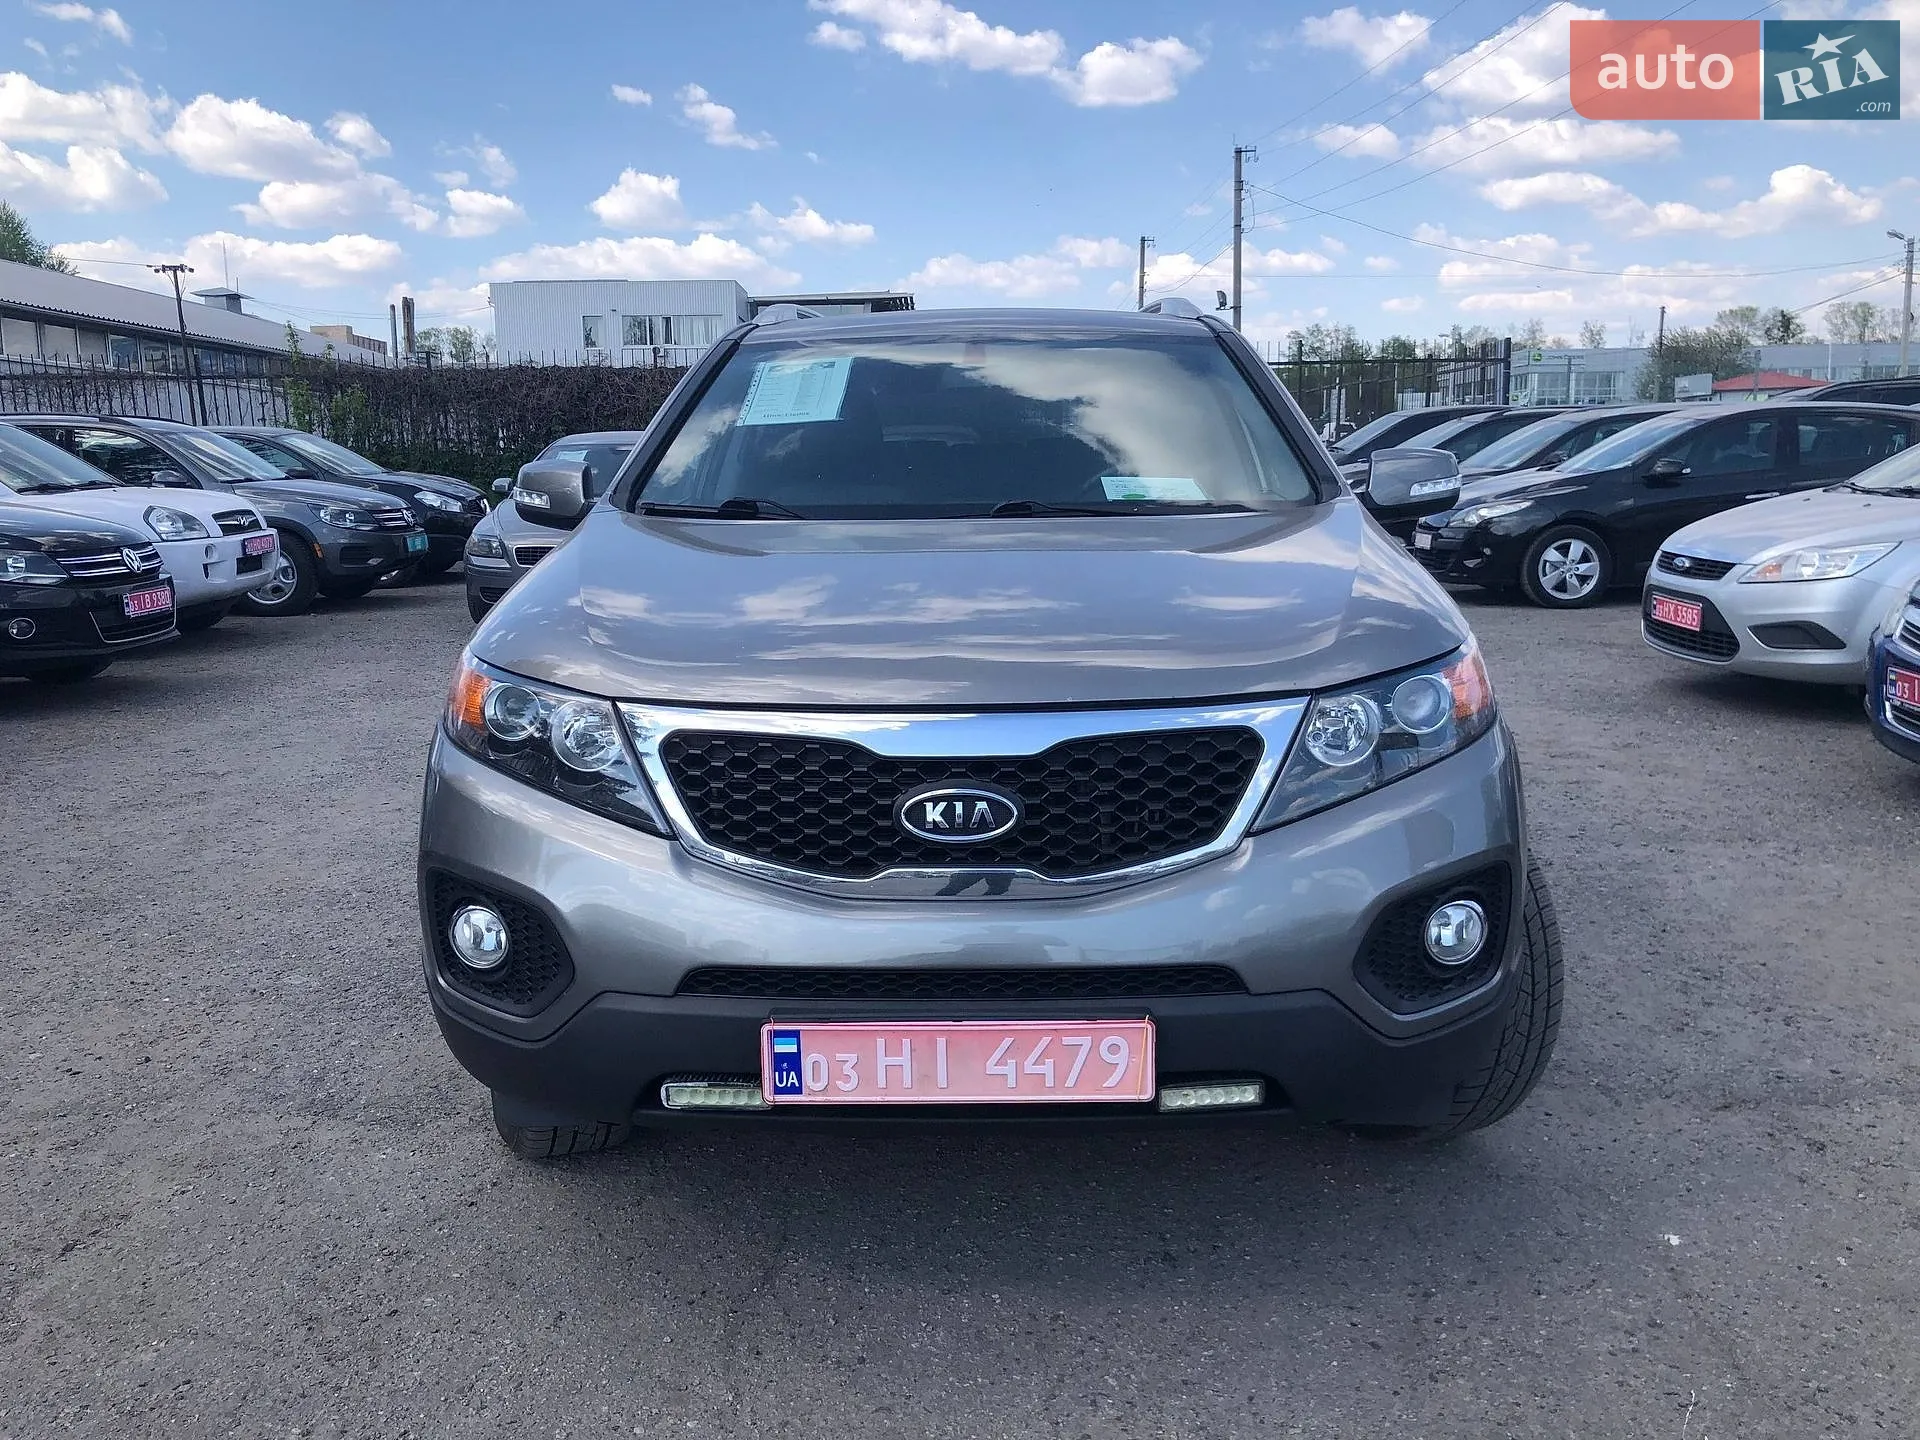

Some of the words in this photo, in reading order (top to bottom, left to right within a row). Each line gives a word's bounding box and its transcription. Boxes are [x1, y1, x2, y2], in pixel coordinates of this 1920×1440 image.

[1676, 605, 1698, 626] 3585
[1896, 681, 1910, 699] 03
[923, 801, 996, 829] KIA
[775, 1071, 799, 1087] UA
[804, 1053, 859, 1092] 03
[985, 1036, 1132, 1089] 4479
